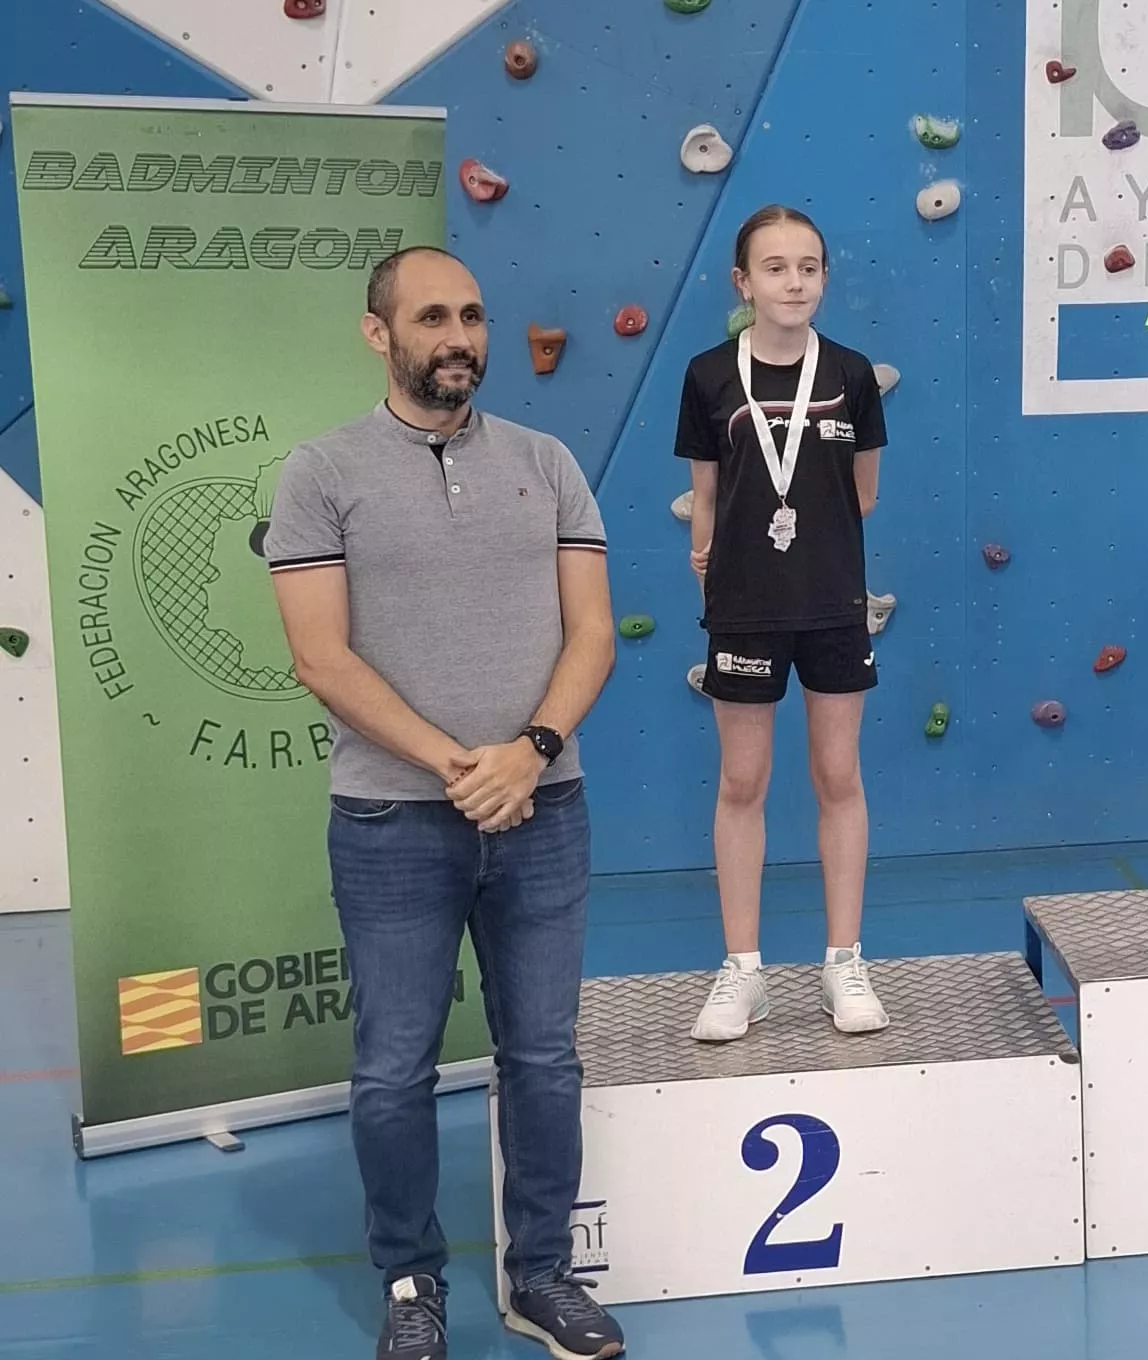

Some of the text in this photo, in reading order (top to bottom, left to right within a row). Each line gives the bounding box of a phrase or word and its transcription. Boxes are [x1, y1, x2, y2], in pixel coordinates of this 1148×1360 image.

[22, 150, 443, 197] BADMINTON
[79, 224, 404, 270] ARAGON
[79, 414, 270, 700] FEDERACION ARAGONESA
[205, 947, 350, 999] GOBIE
[207, 1000, 266, 1041] DE
[741, 1113, 843, 1275] 2
[569, 1211, 608, 1249] nf
